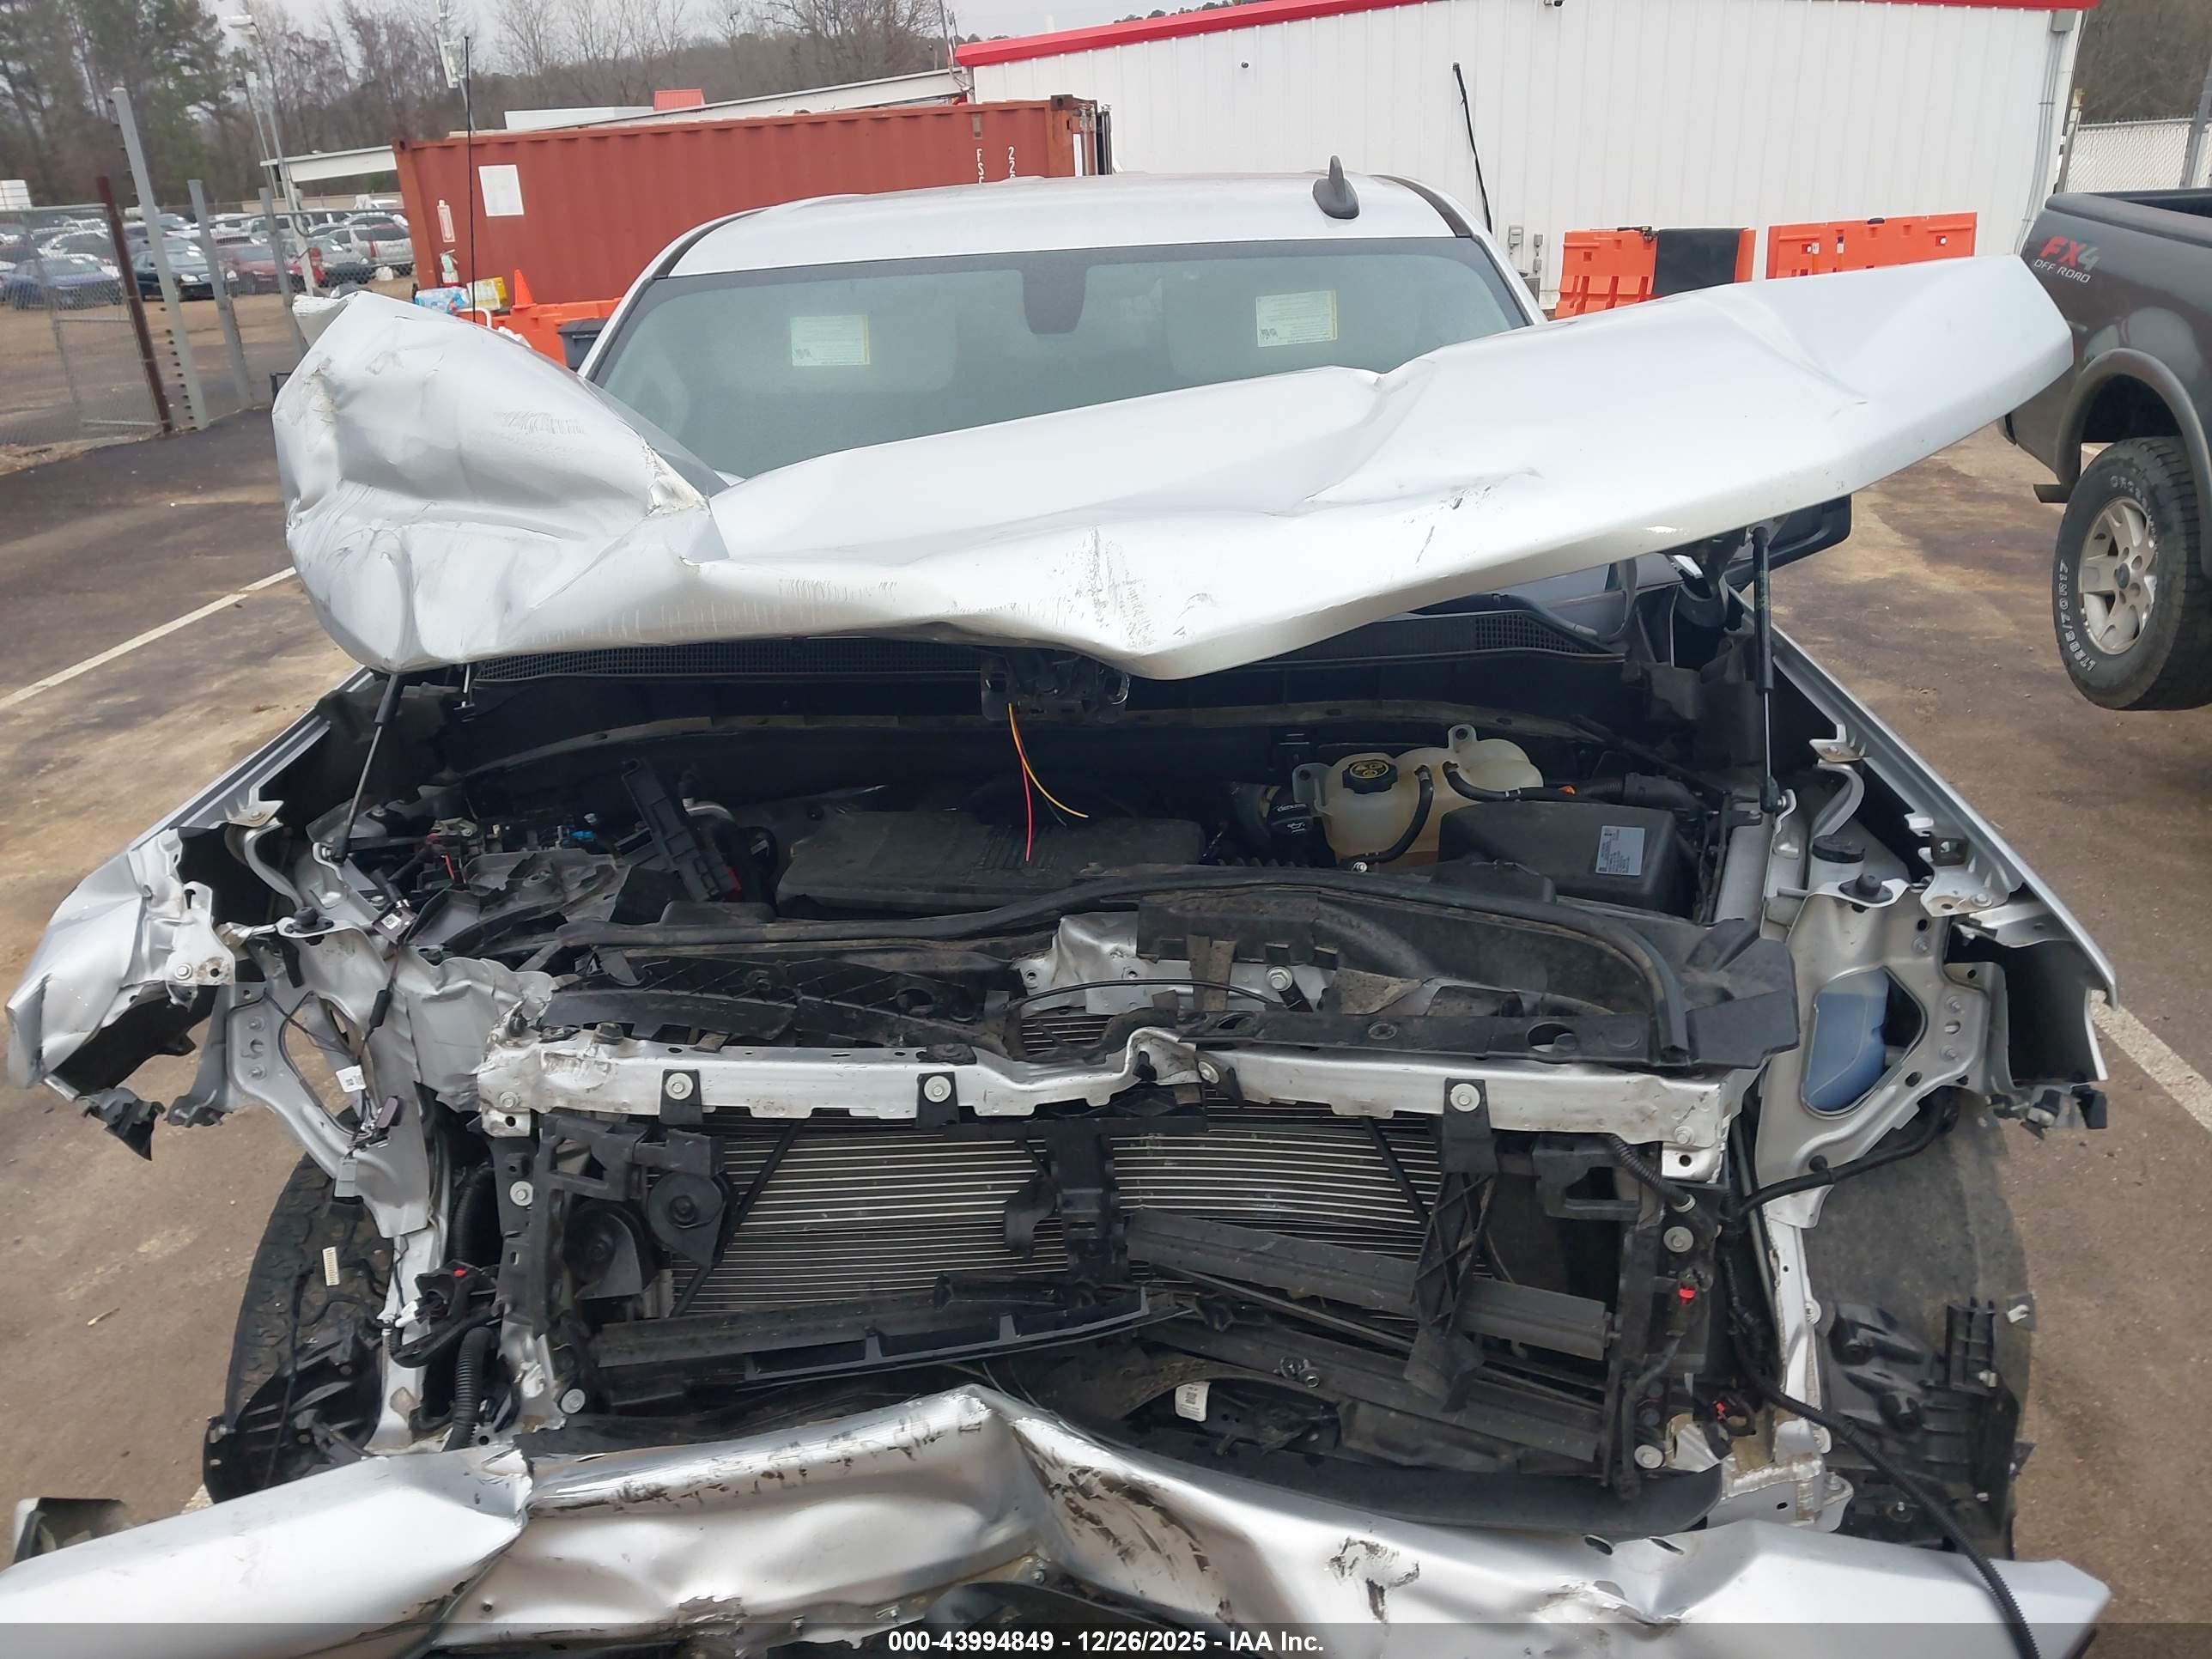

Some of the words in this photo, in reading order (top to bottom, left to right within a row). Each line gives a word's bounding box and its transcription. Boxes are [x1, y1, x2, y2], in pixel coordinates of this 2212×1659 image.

[2039, 235, 2100, 271] FX4
[2033, 258, 2057, 270] OFF
[2057, 266, 2092, 283] ROAD
